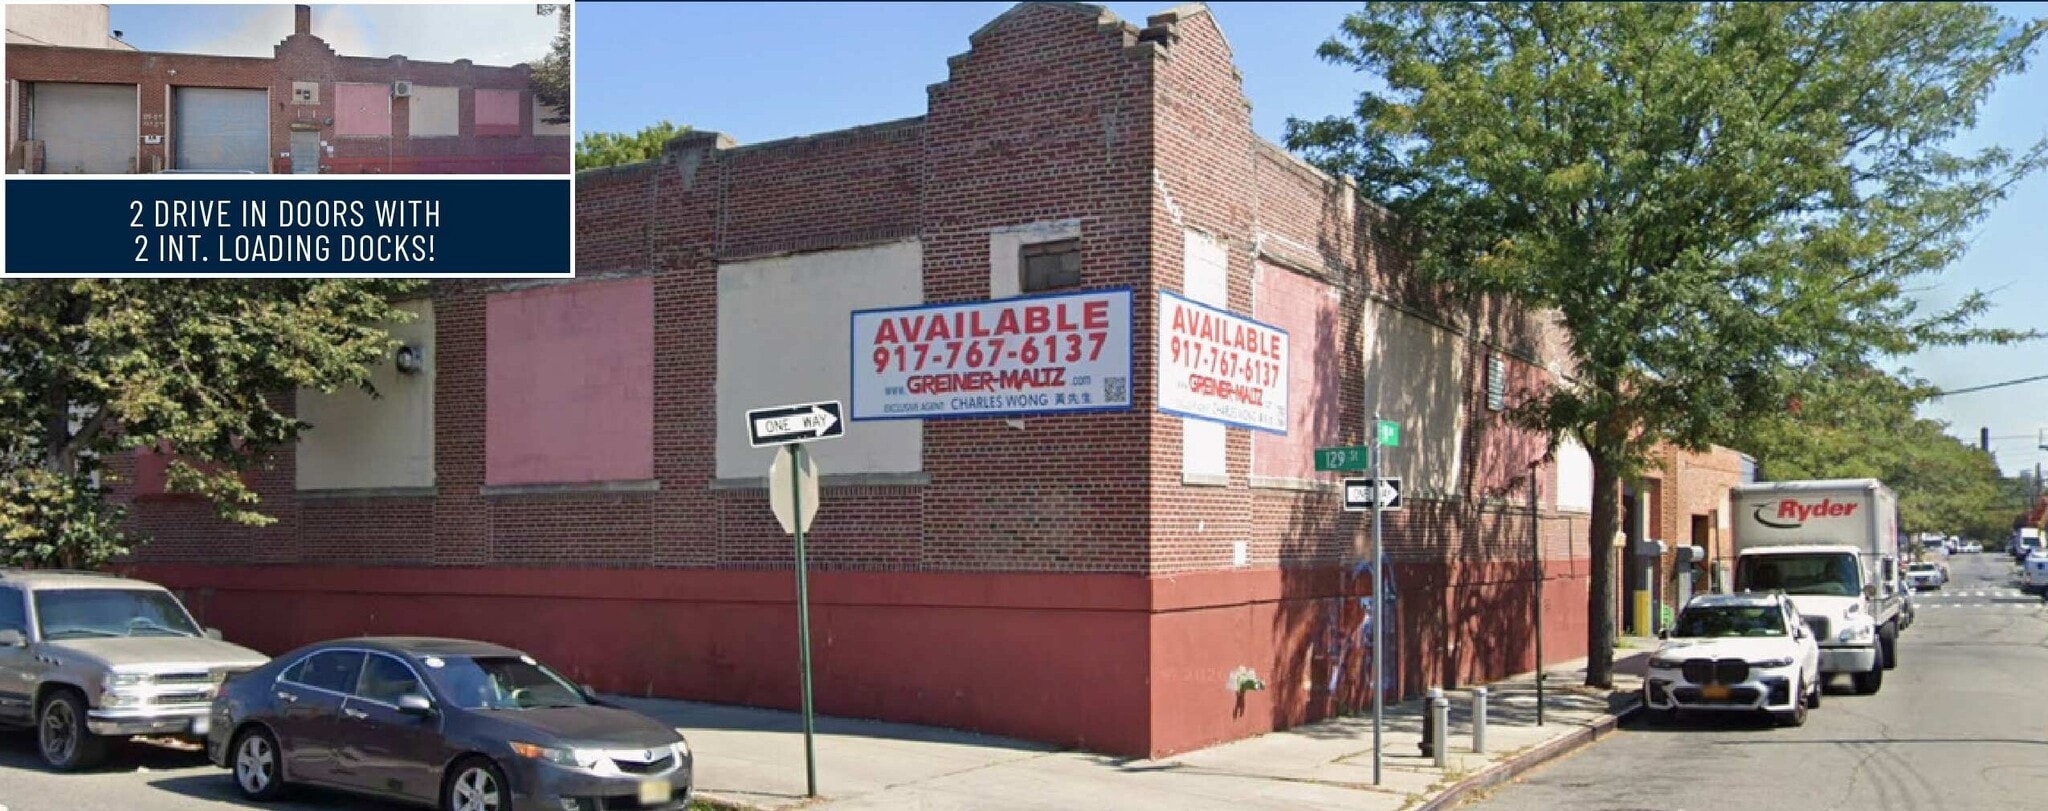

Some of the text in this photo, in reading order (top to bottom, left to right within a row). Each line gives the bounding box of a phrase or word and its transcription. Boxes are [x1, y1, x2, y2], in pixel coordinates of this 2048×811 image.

[874, 301, 1109, 345] AVAILABLE
[1172, 304, 1280, 360] AVAILABLE
[873, 332, 1108, 374] 917-767-6137
[1171, 335, 1279, 388] 917-767-6137
[906, 367, 1066, 395] GREINER-MALTZ
[951, 395, 1002, 410] CHARLES
[1005, 393, 1049, 408] WONG
[765, 414, 826, 433] ONE WAY
[1325, 450, 1345, 469] 129
[1777, 498, 1859, 522] Ryder
